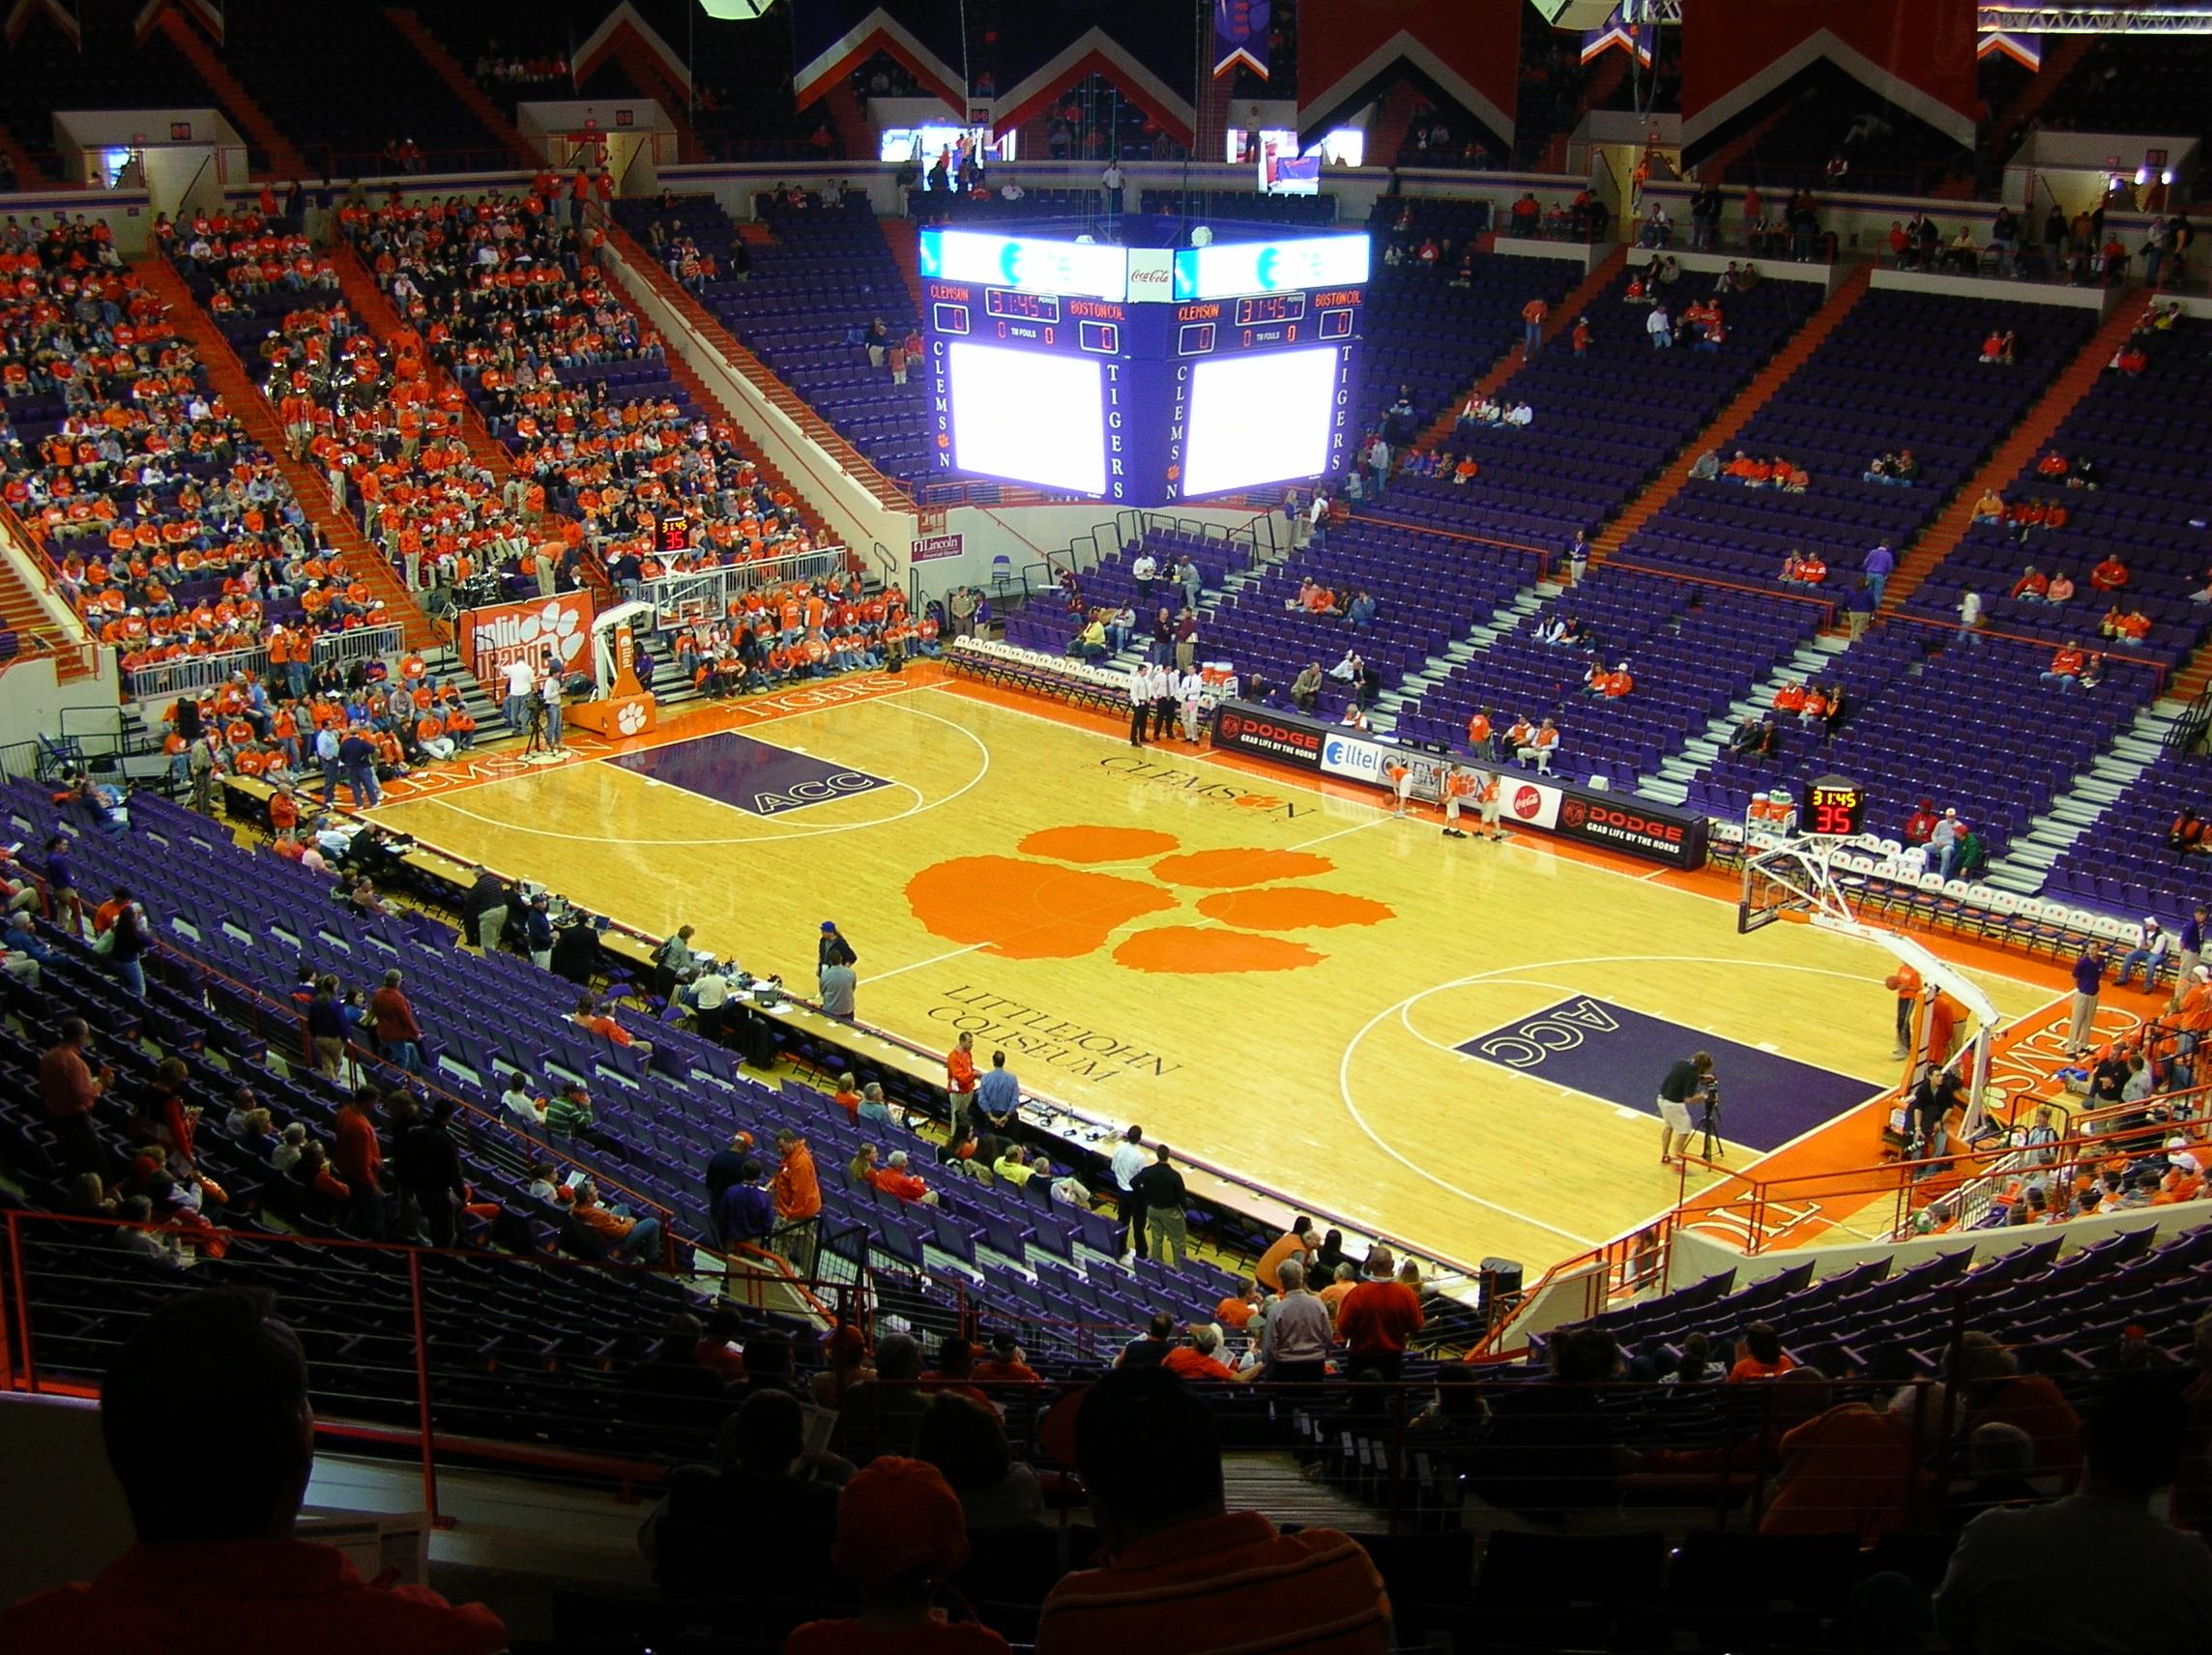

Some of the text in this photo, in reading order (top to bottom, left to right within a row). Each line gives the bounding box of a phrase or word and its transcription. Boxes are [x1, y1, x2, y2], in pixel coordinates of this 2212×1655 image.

[930, 284, 970, 302] CLEMSON
[993, 291, 1038, 317] 31:45
[953, 308, 965, 330] 0
[1178, 304, 1221, 321] CLEMSON
[1337, 312, 1348, 333] 0
[998, 321, 1006, 338] 0
[1045, 327, 1054, 344] 0
[1101, 327, 1112, 349] 0
[1199, 327, 1210, 349] 0
[1243, 330, 1252, 347] 0
[1288, 325, 1296, 341] 0
[1331, 345, 1352, 470] TIGERS
[1107, 364, 1124, 499] TIGERS
[665, 531, 684, 550] 35
[924, 536, 958, 551] Lincoln
[726, 675, 909, 717] TIGERS
[1243, 719, 1321, 749] DODGE
[1240, 734, 1317, 761] GRAB LIFE BY THE HORNS
[1326, 741, 1378, 770] alltel
[754, 772, 875, 813] ACC
[1813, 790, 1856, 808] 31:45
[1588, 806, 1684, 843] DODGE
[1817, 806, 1850, 832] 35
[1586, 823, 1680, 854] GRAB LIFE BY THE HORNS
[942, 984, 1185, 1077] LITTLEJOHN
[1480, 1000, 1620, 1068] ACC
[927, 1006, 1120, 1082] COLISEUM
